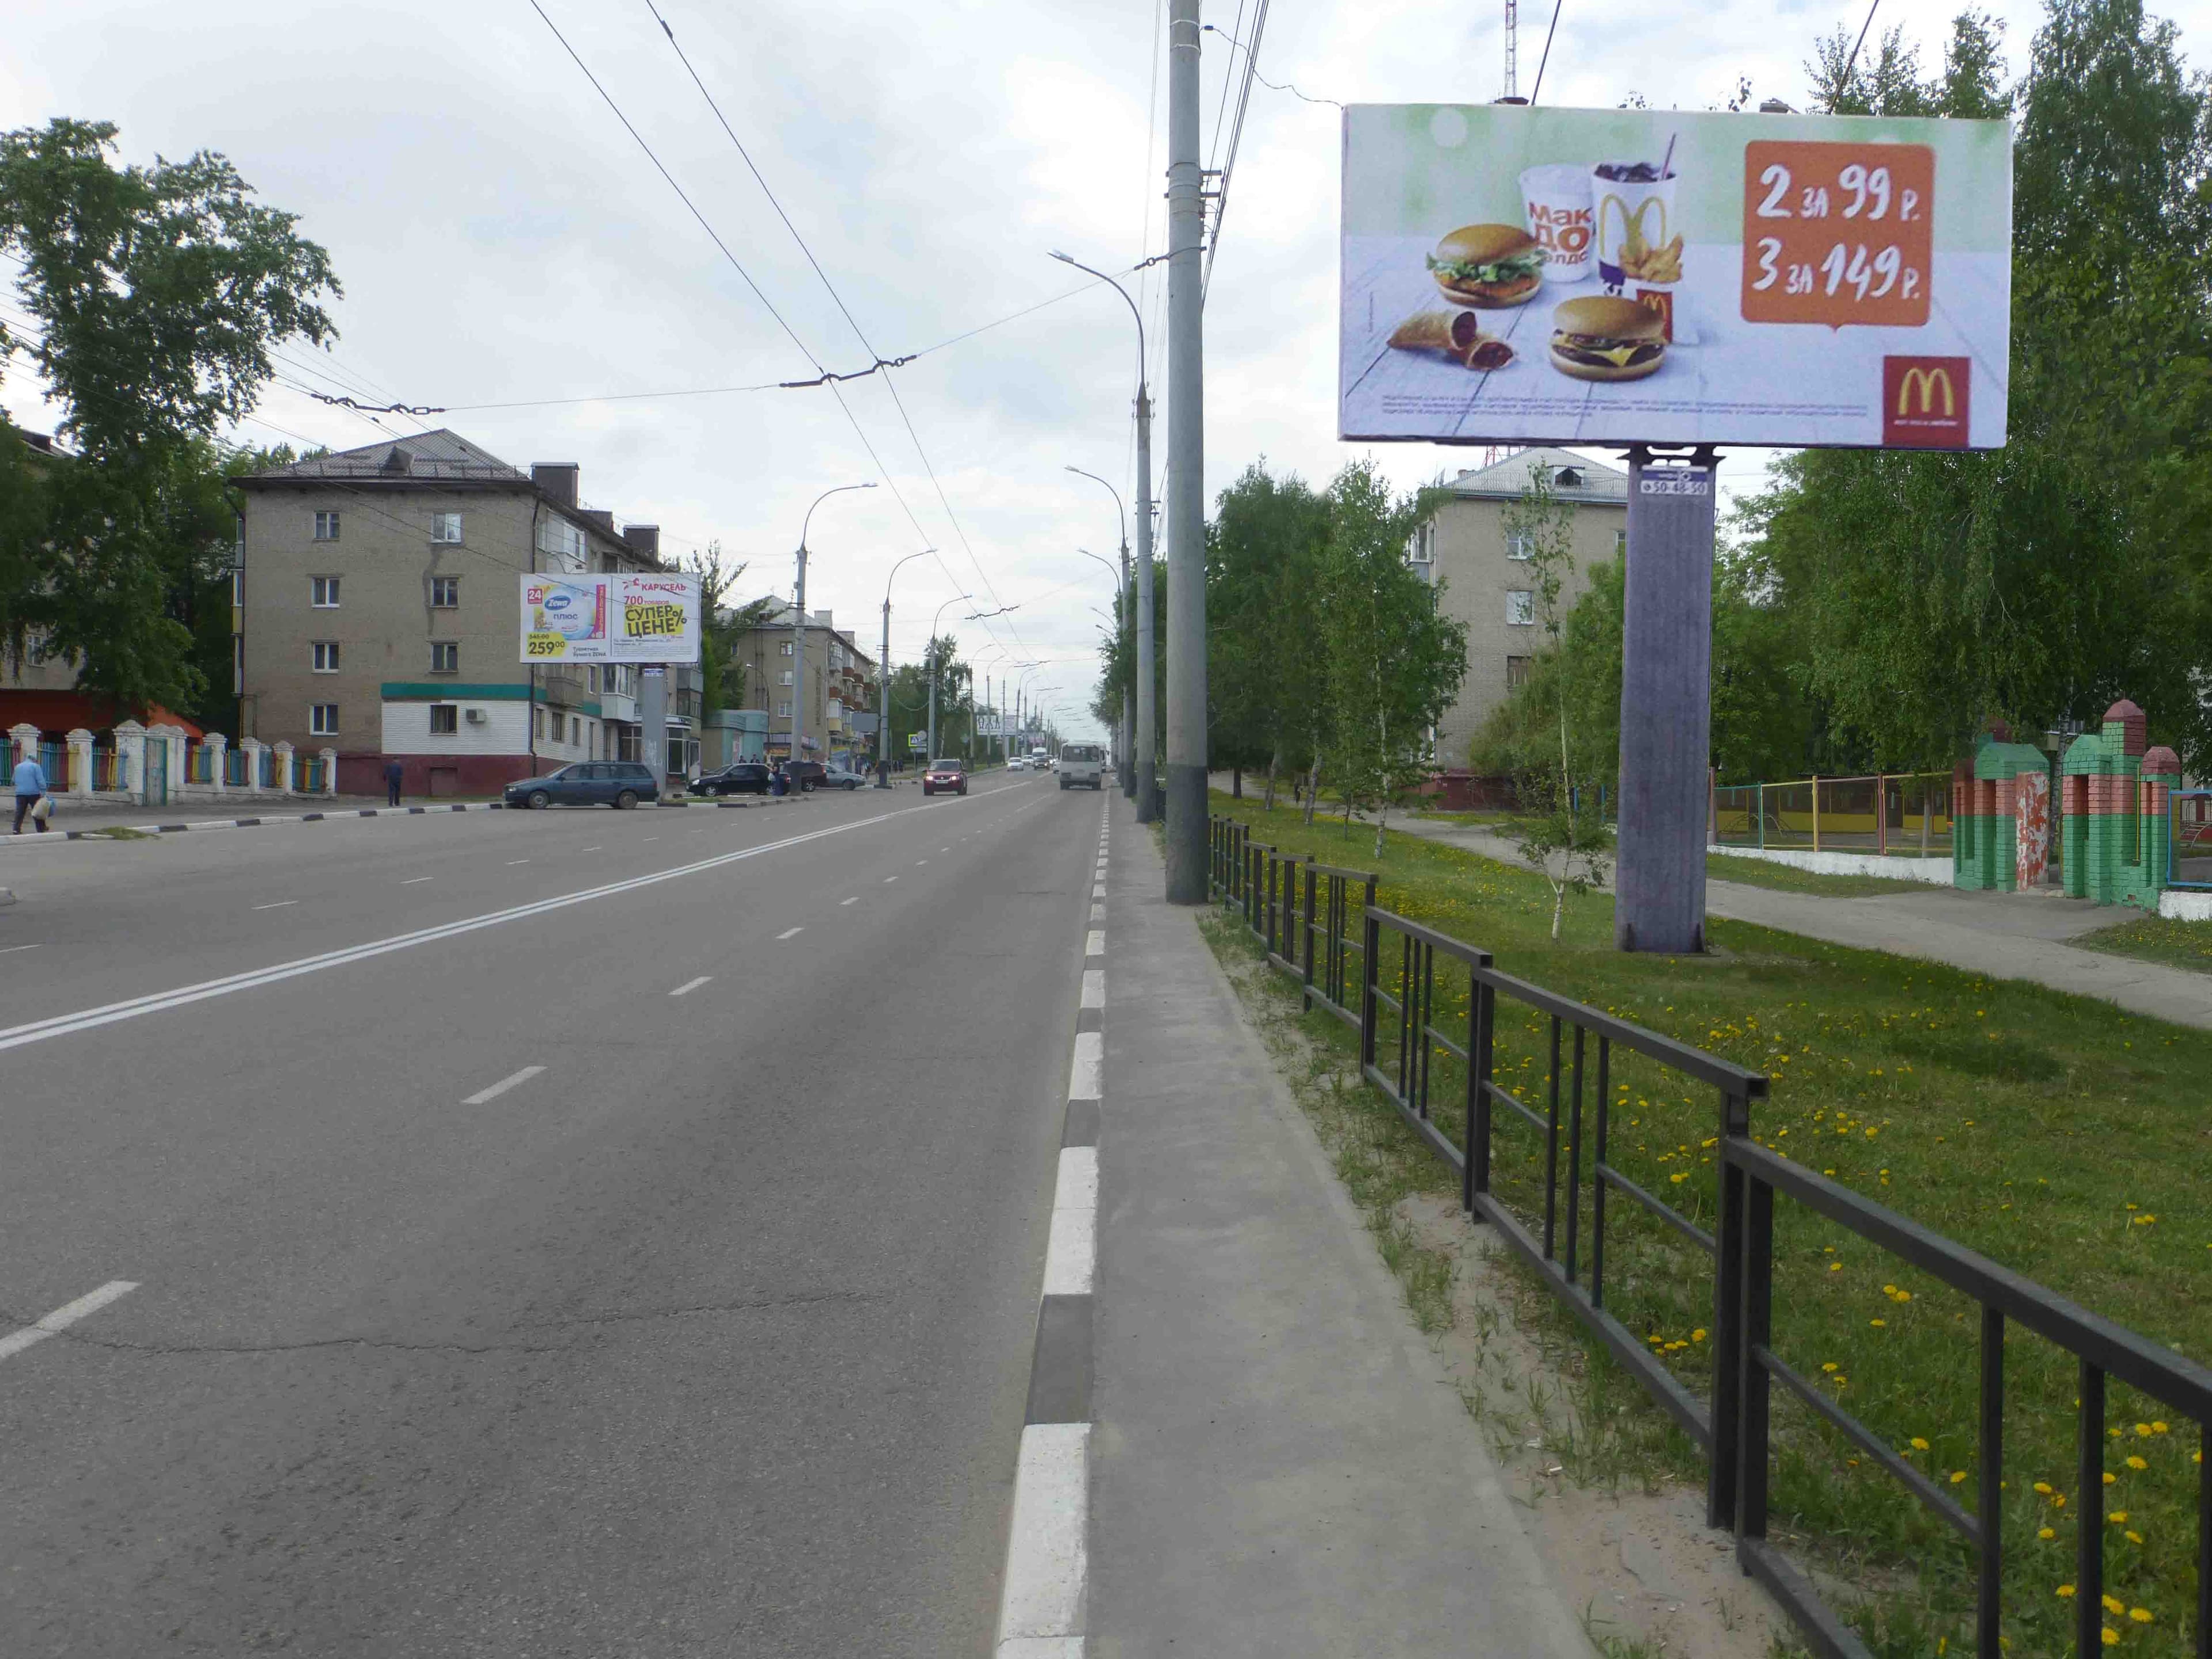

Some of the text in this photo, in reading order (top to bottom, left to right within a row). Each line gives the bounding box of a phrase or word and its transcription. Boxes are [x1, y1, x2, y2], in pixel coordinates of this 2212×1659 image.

[1756, 164, 1792, 219] 2
[1838, 164, 1892, 221] 99
[1752, 237, 1783, 291] 3
[1820, 243, 1902, 302] 149
[528, 590, 542, 600] 24
[642, 583, 686, 592] КАРУСЕЛЬ
[623, 596, 643, 605] 700
[626, 605, 673, 622] СУПЕР
[627, 618, 676, 638] ЦЕНЕ
[529, 642, 555, 655] 259
